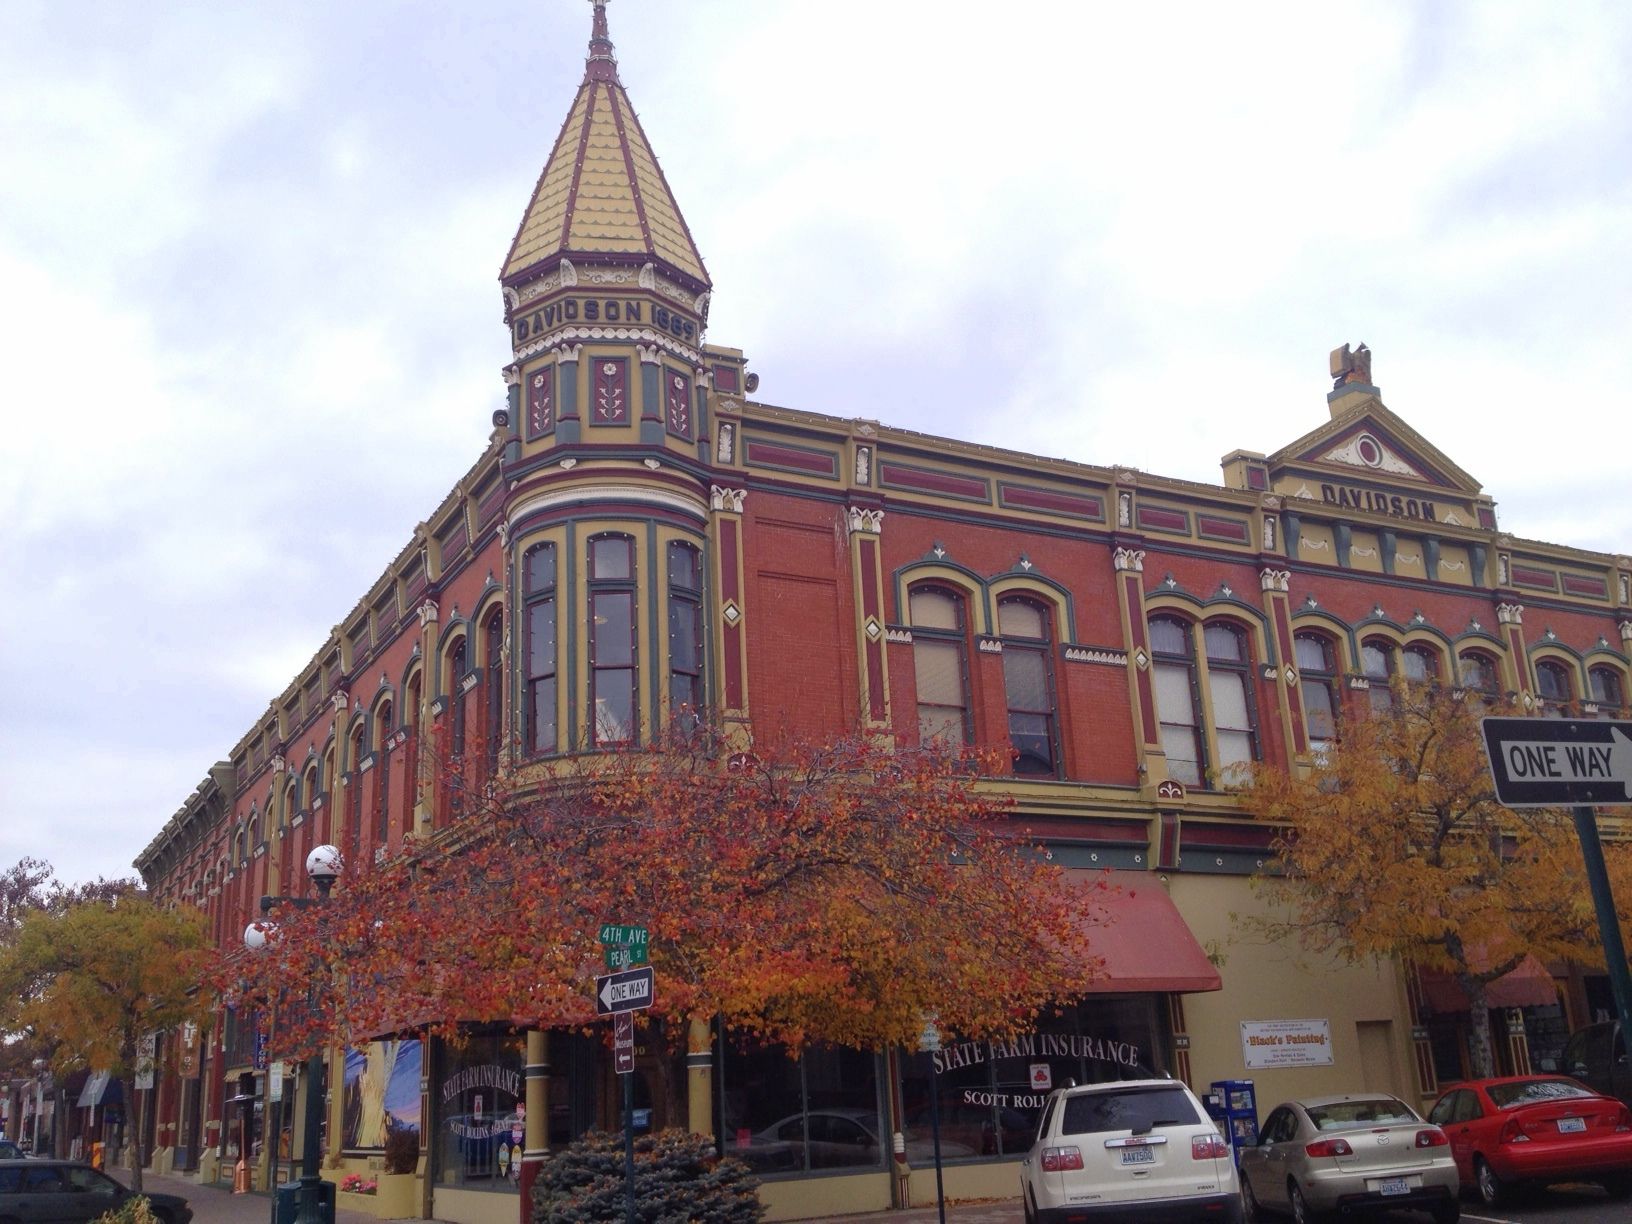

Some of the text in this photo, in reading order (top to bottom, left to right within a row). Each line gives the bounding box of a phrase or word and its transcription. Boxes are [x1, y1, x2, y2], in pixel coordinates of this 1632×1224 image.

[517, 299, 694, 341] DAVIDSON 1889
[1321, 483, 1436, 520] DAVIDSON
[1509, 745, 1612, 778] ONE WAY
[602, 927, 647, 944] 4TH AVE
[611, 948, 633, 966] PEARL
[610, 980, 646, 1001] ONE WAY
[932, 1034, 1138, 1074] STATE FARM INSURANCE
[479, 1064, 520, 1098] INSURANCE
[963, 1090, 1009, 1108] SCOTT
